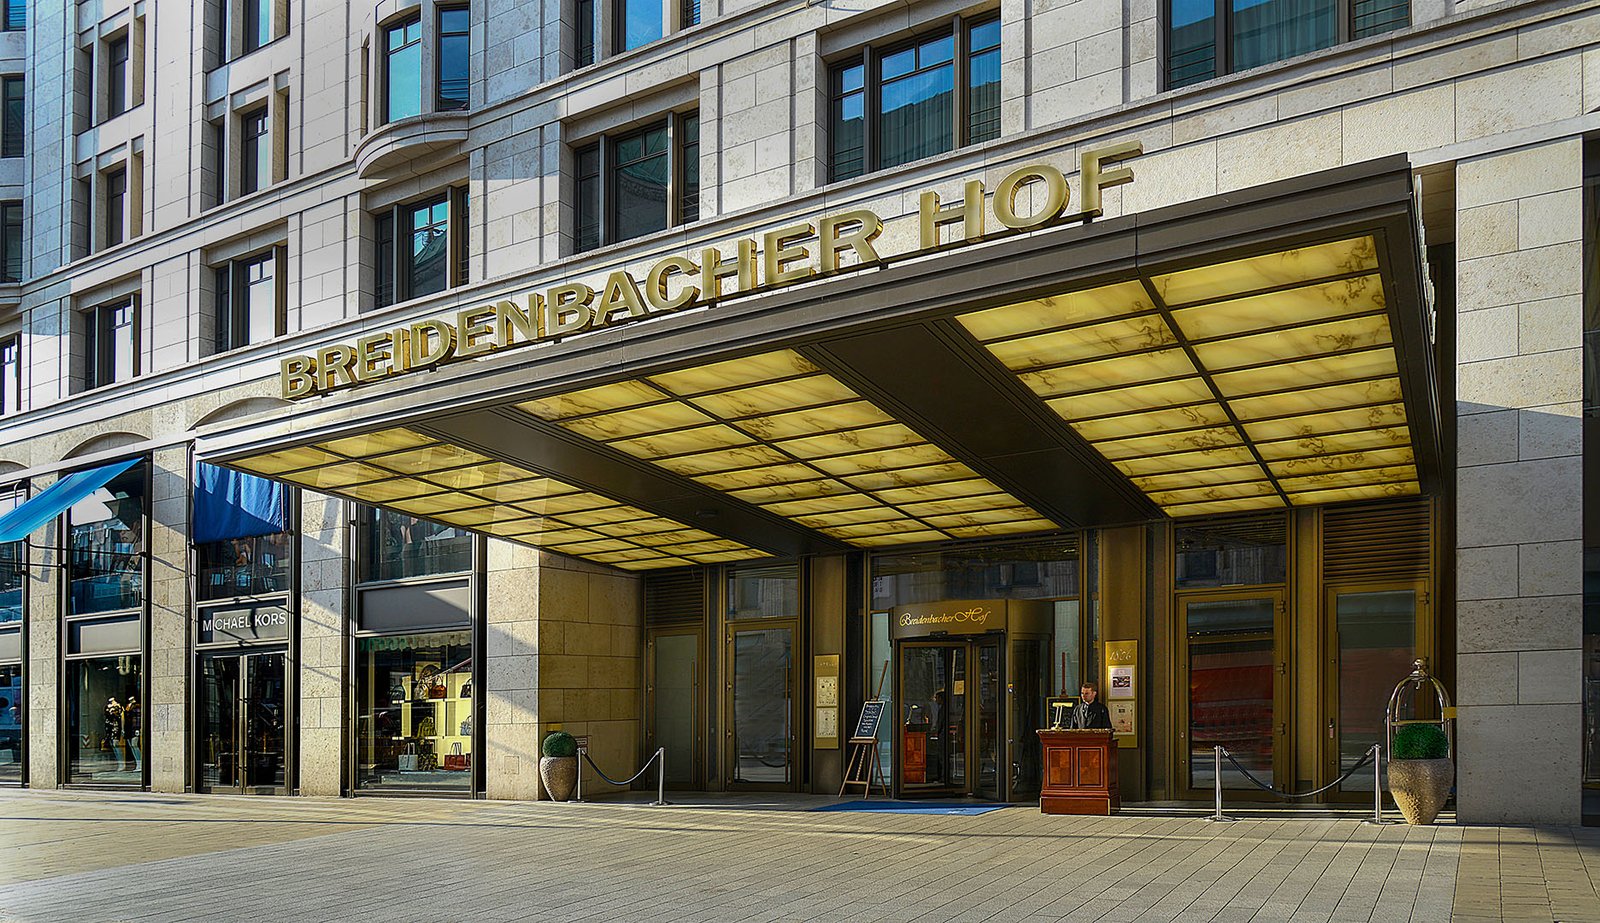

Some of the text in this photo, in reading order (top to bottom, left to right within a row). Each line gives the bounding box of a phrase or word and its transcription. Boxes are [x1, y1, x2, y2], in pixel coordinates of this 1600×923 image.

[281, 140, 1143, 398] BREIDENBACHER HOF
[203, 612, 287, 632] MICHAEL KORS
[899, 607, 991, 627] Breidenbacher Hof
